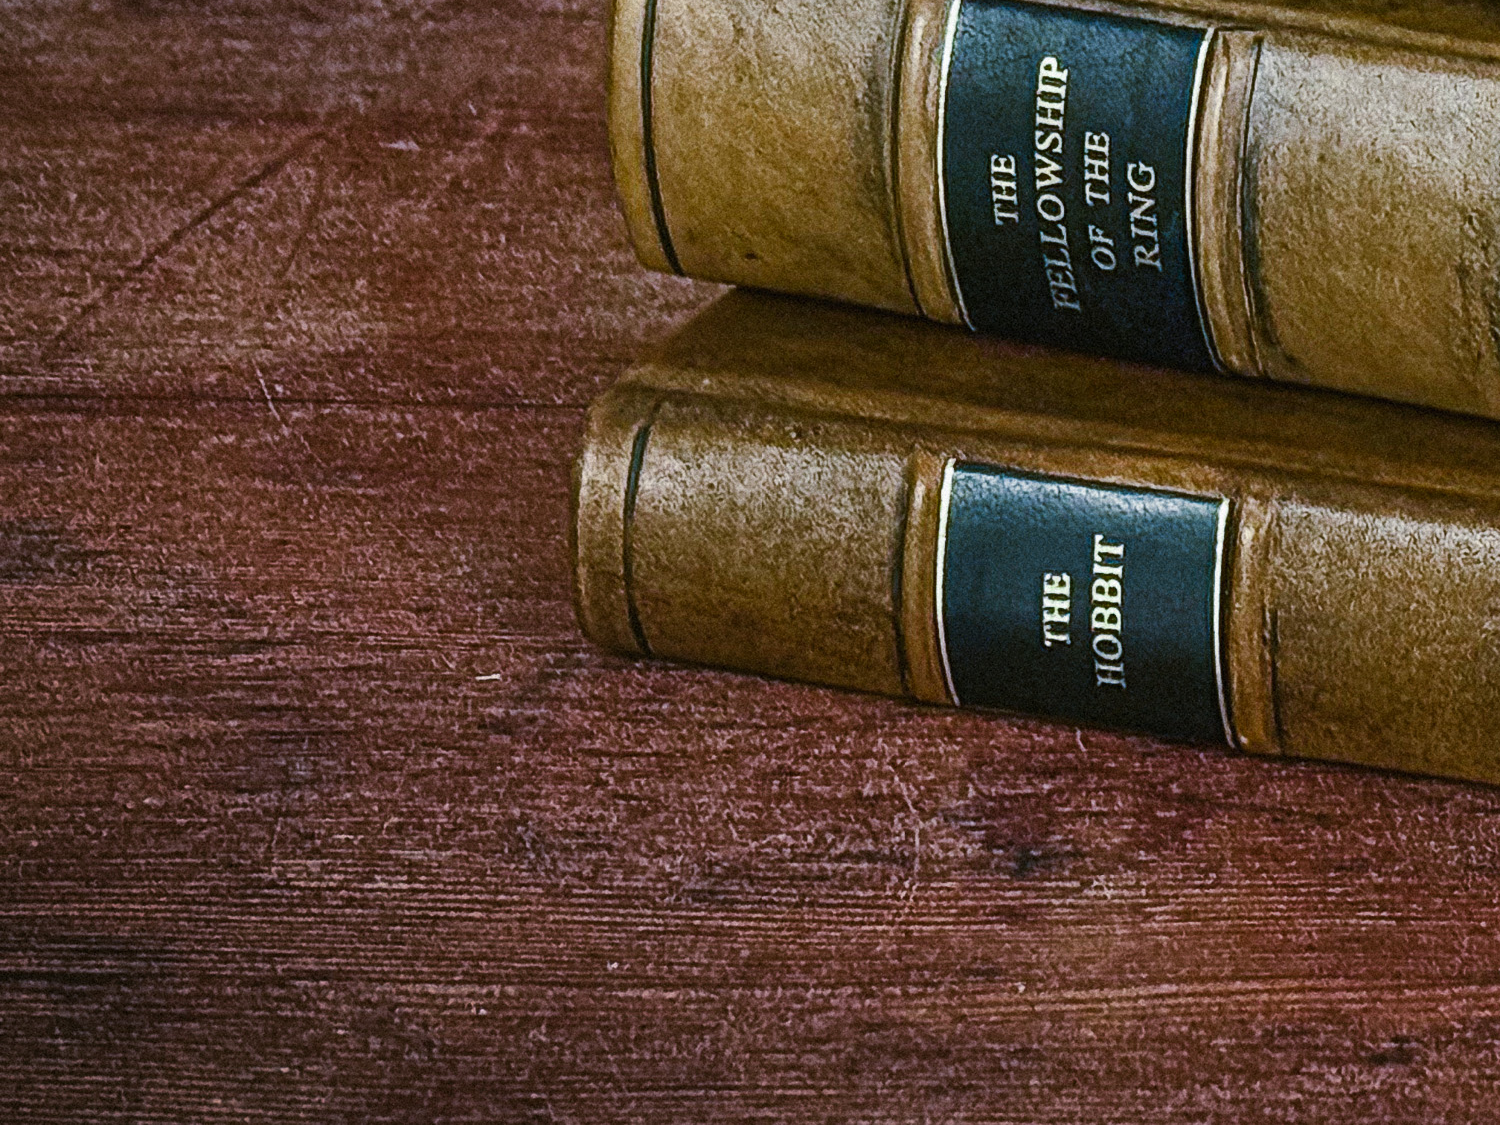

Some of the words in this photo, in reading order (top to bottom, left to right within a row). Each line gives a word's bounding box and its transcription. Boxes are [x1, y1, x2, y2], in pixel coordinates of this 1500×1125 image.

[991, 154, 1019, 225] THE
[1035, 56, 1081, 312] FELLOWSHIP
[1084, 131, 1110, 206] THE
[1088, 224, 1117, 271] OF
[1127, 161, 1162, 272] RING
[1042, 572, 1071, 647] THE
[1091, 534, 1126, 689] HOBBIT
